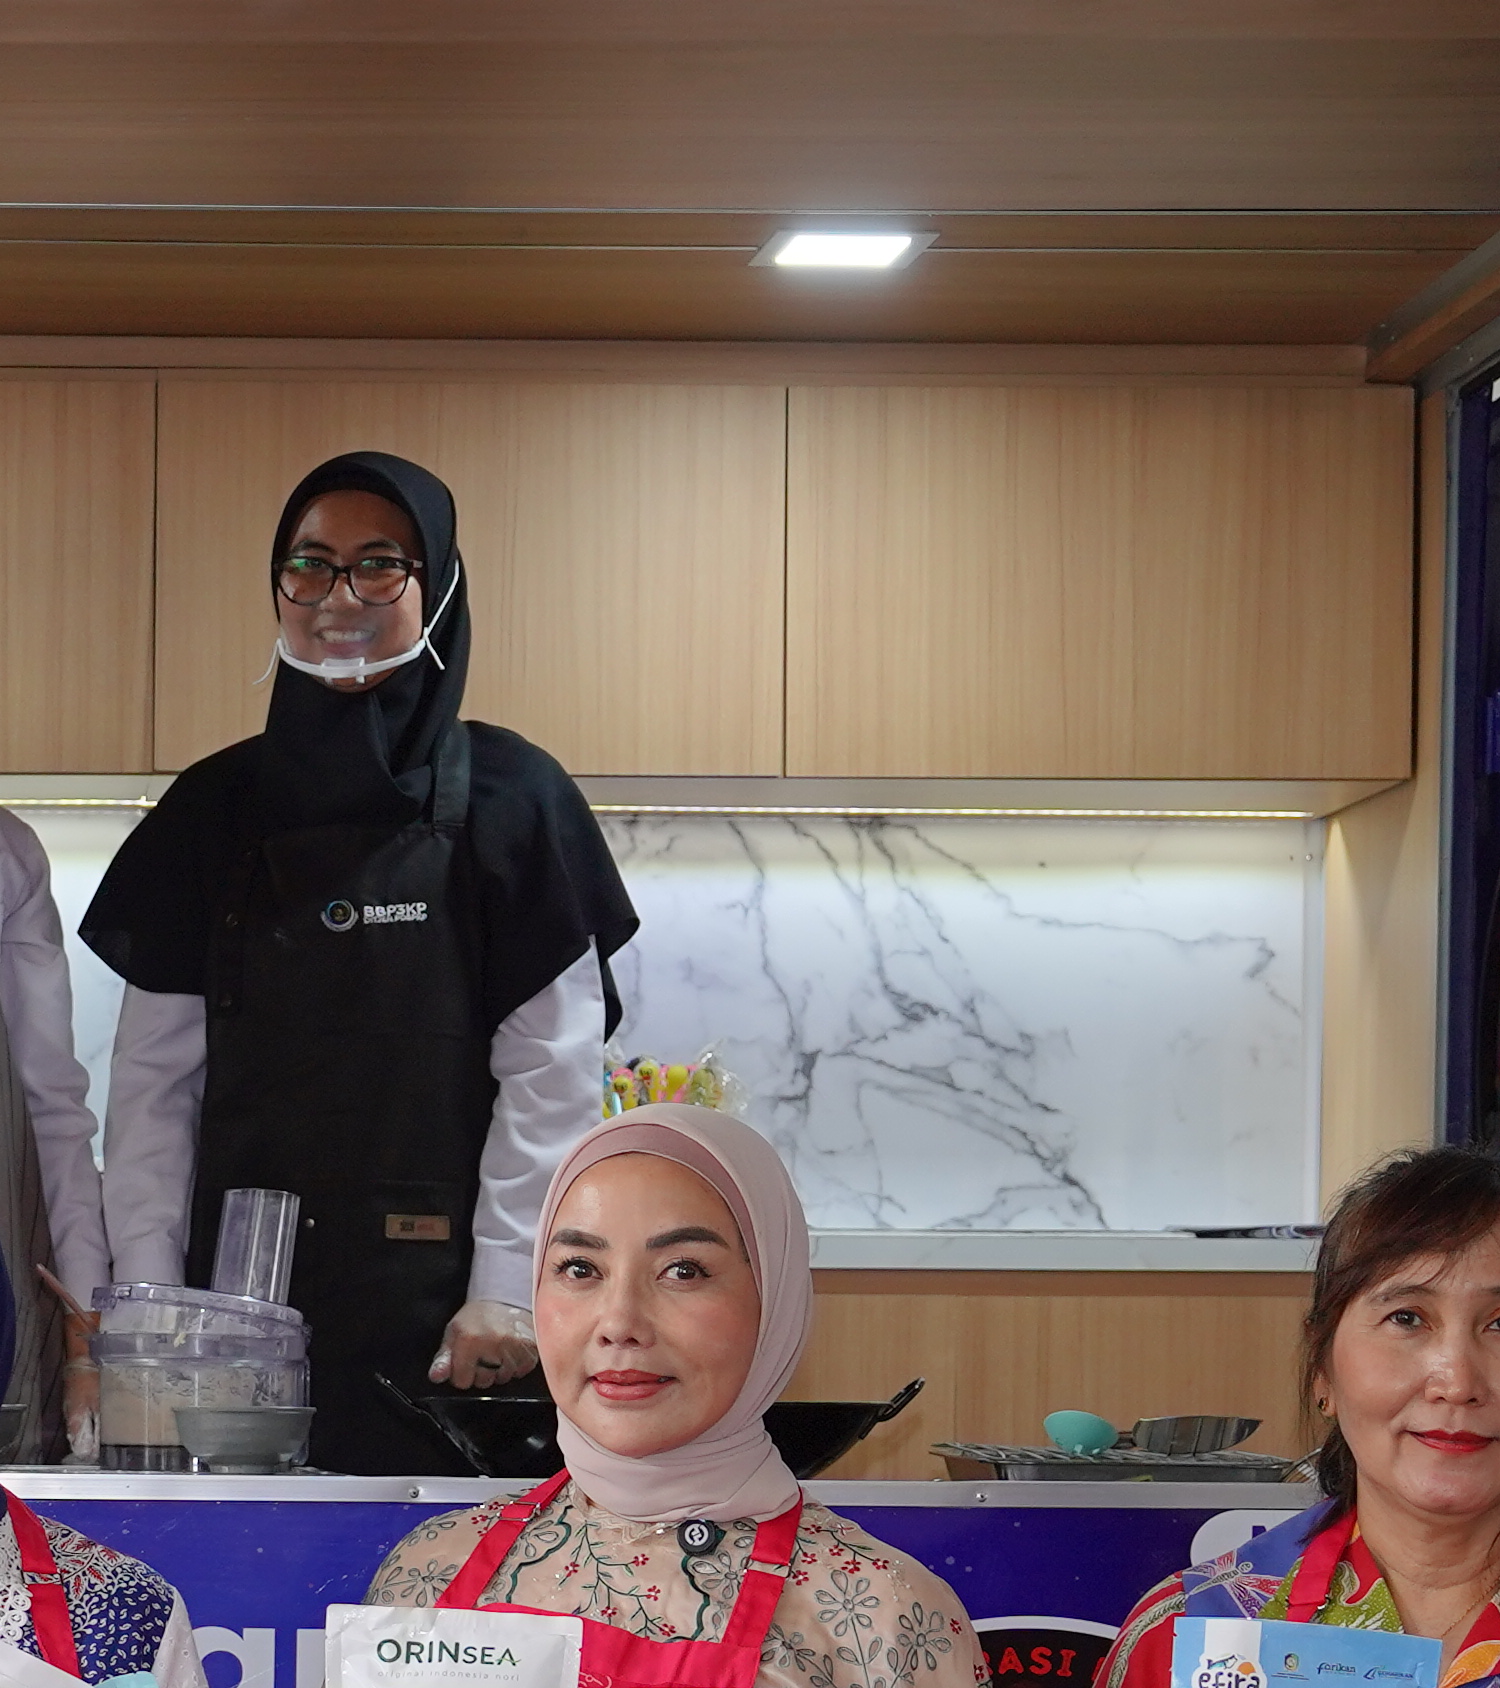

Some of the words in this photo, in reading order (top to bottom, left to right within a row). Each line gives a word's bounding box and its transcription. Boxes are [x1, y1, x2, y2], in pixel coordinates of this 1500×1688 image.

[376, 1638, 521, 1667] ORINSEA
[377, 1670, 425, 1680] original
[429, 1670, 490, 1680] indonesia
[494, 1674, 520, 1682] nori
